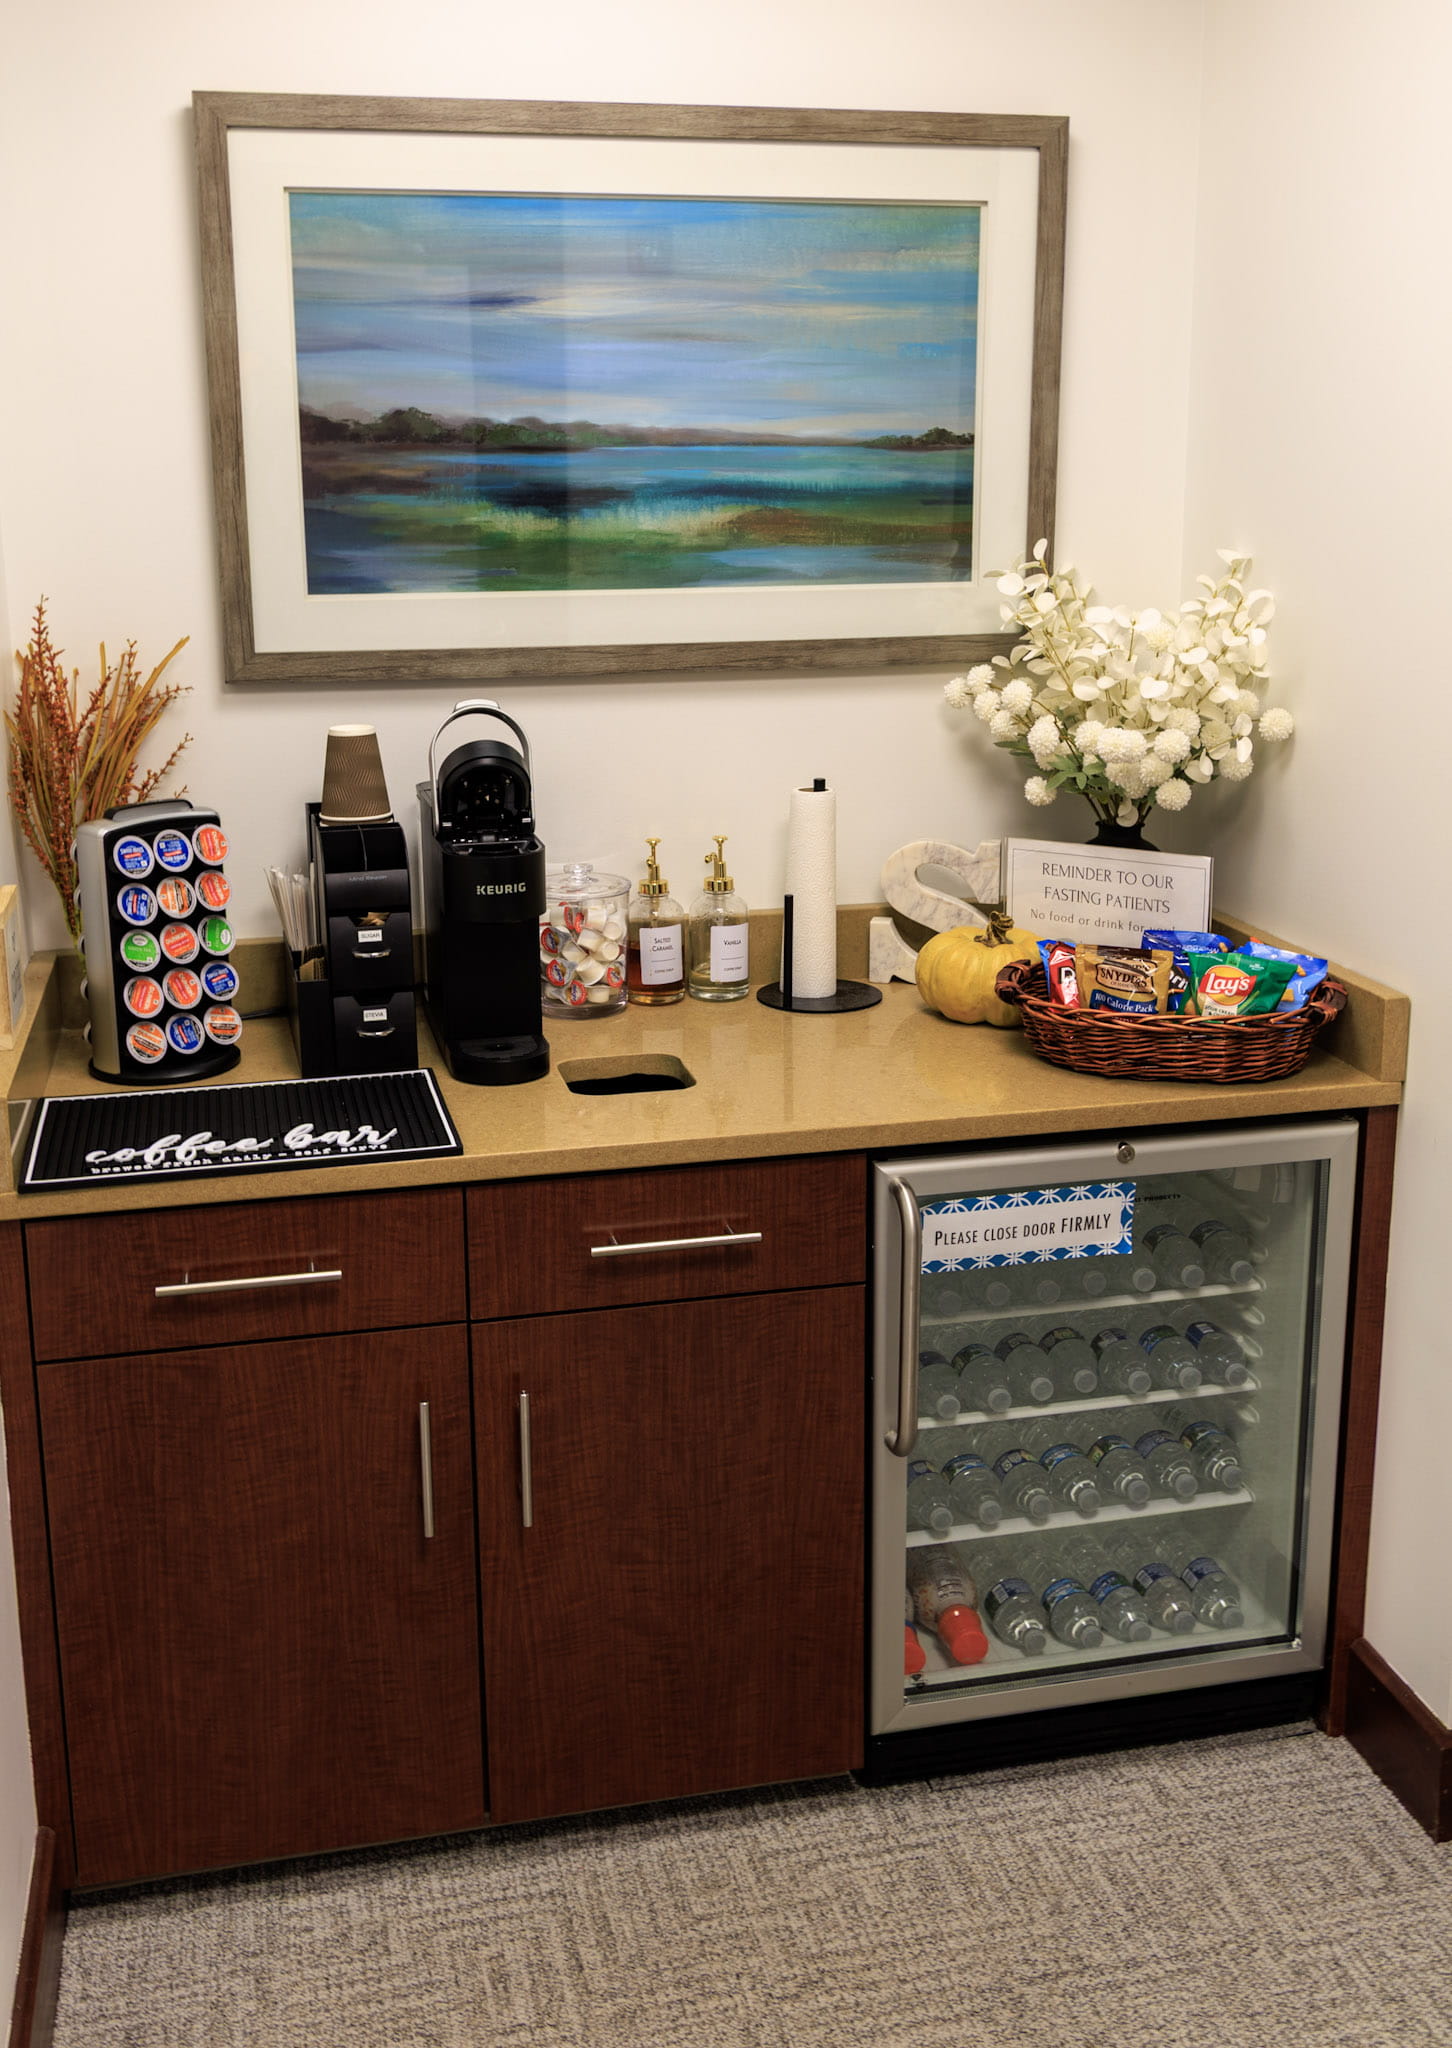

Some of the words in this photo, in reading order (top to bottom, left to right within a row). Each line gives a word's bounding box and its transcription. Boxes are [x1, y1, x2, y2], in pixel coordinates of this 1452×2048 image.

[476, 882, 526, 896] KEURIG
[1042, 863, 1112, 883] REMINDER
[1117, 871, 1137, 886] TO
[1142, 874, 1174, 889] OUR
[1044, 887, 1101, 906] FASTING
[1106, 893, 1171, 914] PATIENTS
[1031, 909, 1045, 920] No
[1050, 909, 1074, 924] food
[1079, 917, 1090, 925] or
[1095, 916, 1124, 930] drink
[1128, 920, 1144, 931] for
[1106, 997, 1134, 1012] Calorie
[1135, 1003, 1154, 1013] Pack
[85, 1131, 274, 1165] coffee
[284, 1123, 398, 1150] bar
[91, 1164, 153, 1174] brewed
[163, 1158, 212, 1168] fresh
[222, 1153, 272, 1163] daily
[294, 1148, 332, 1156] self
[341, 1144, 388, 1152] serve
[934, 1230, 978, 1246] PLEASE
[983, 1225, 1018, 1242] CLOSE
[1023, 1221, 1056, 1238] DOOR
[1060, 1213, 1111, 1234] FIRMLY
